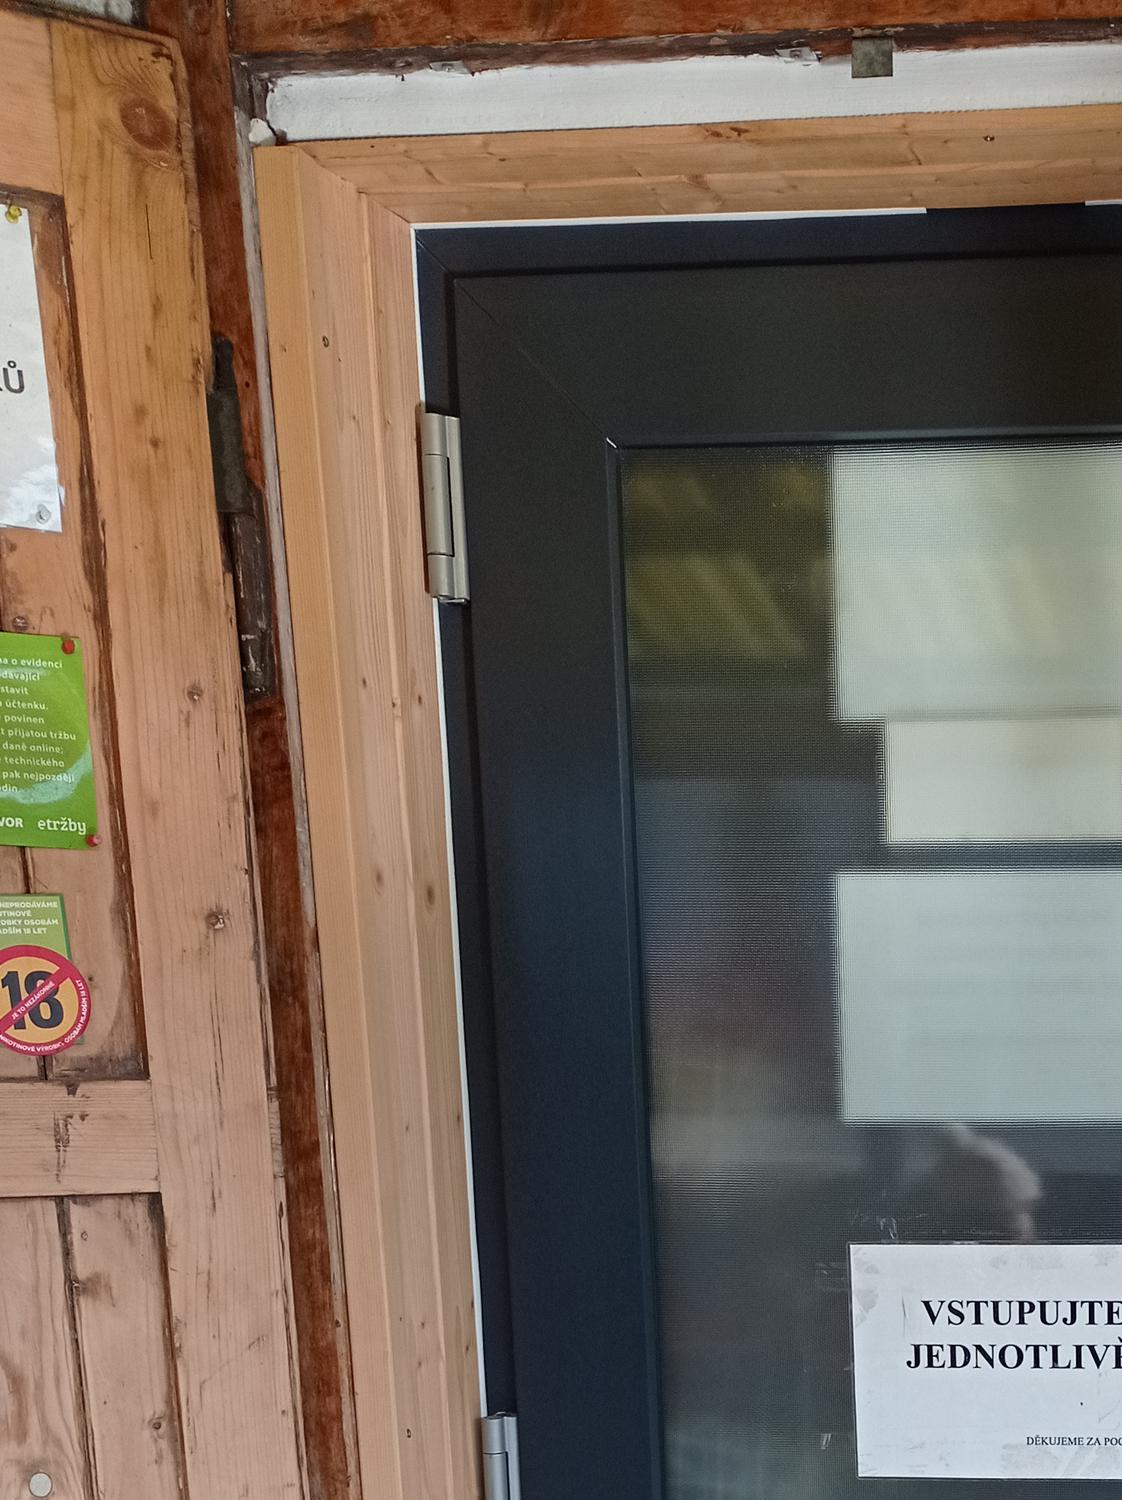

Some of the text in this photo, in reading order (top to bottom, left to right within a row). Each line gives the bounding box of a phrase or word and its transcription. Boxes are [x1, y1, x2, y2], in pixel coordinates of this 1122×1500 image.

[20, 657, 63, 669] evidenci
[0, 670, 40, 682] dávající
[4, 714, 45, 724] povinen
[50, 729, 76, 740] tržbu
[2, 741, 27, 752] daně
[4, 756, 65, 768] technického
[2, 770, 75, 783] pak nejpozději
[38, 816, 86, 835] etržby
[0, 909, 32, 917] TINOVÉ
[24, 917, 59, 925] OSOBÁM
[1, 971, 64, 1030] 18
[1026, 1433, 1085, 1447] DĚKUJEME
[1086, 1437, 1101, 1447] ZA
